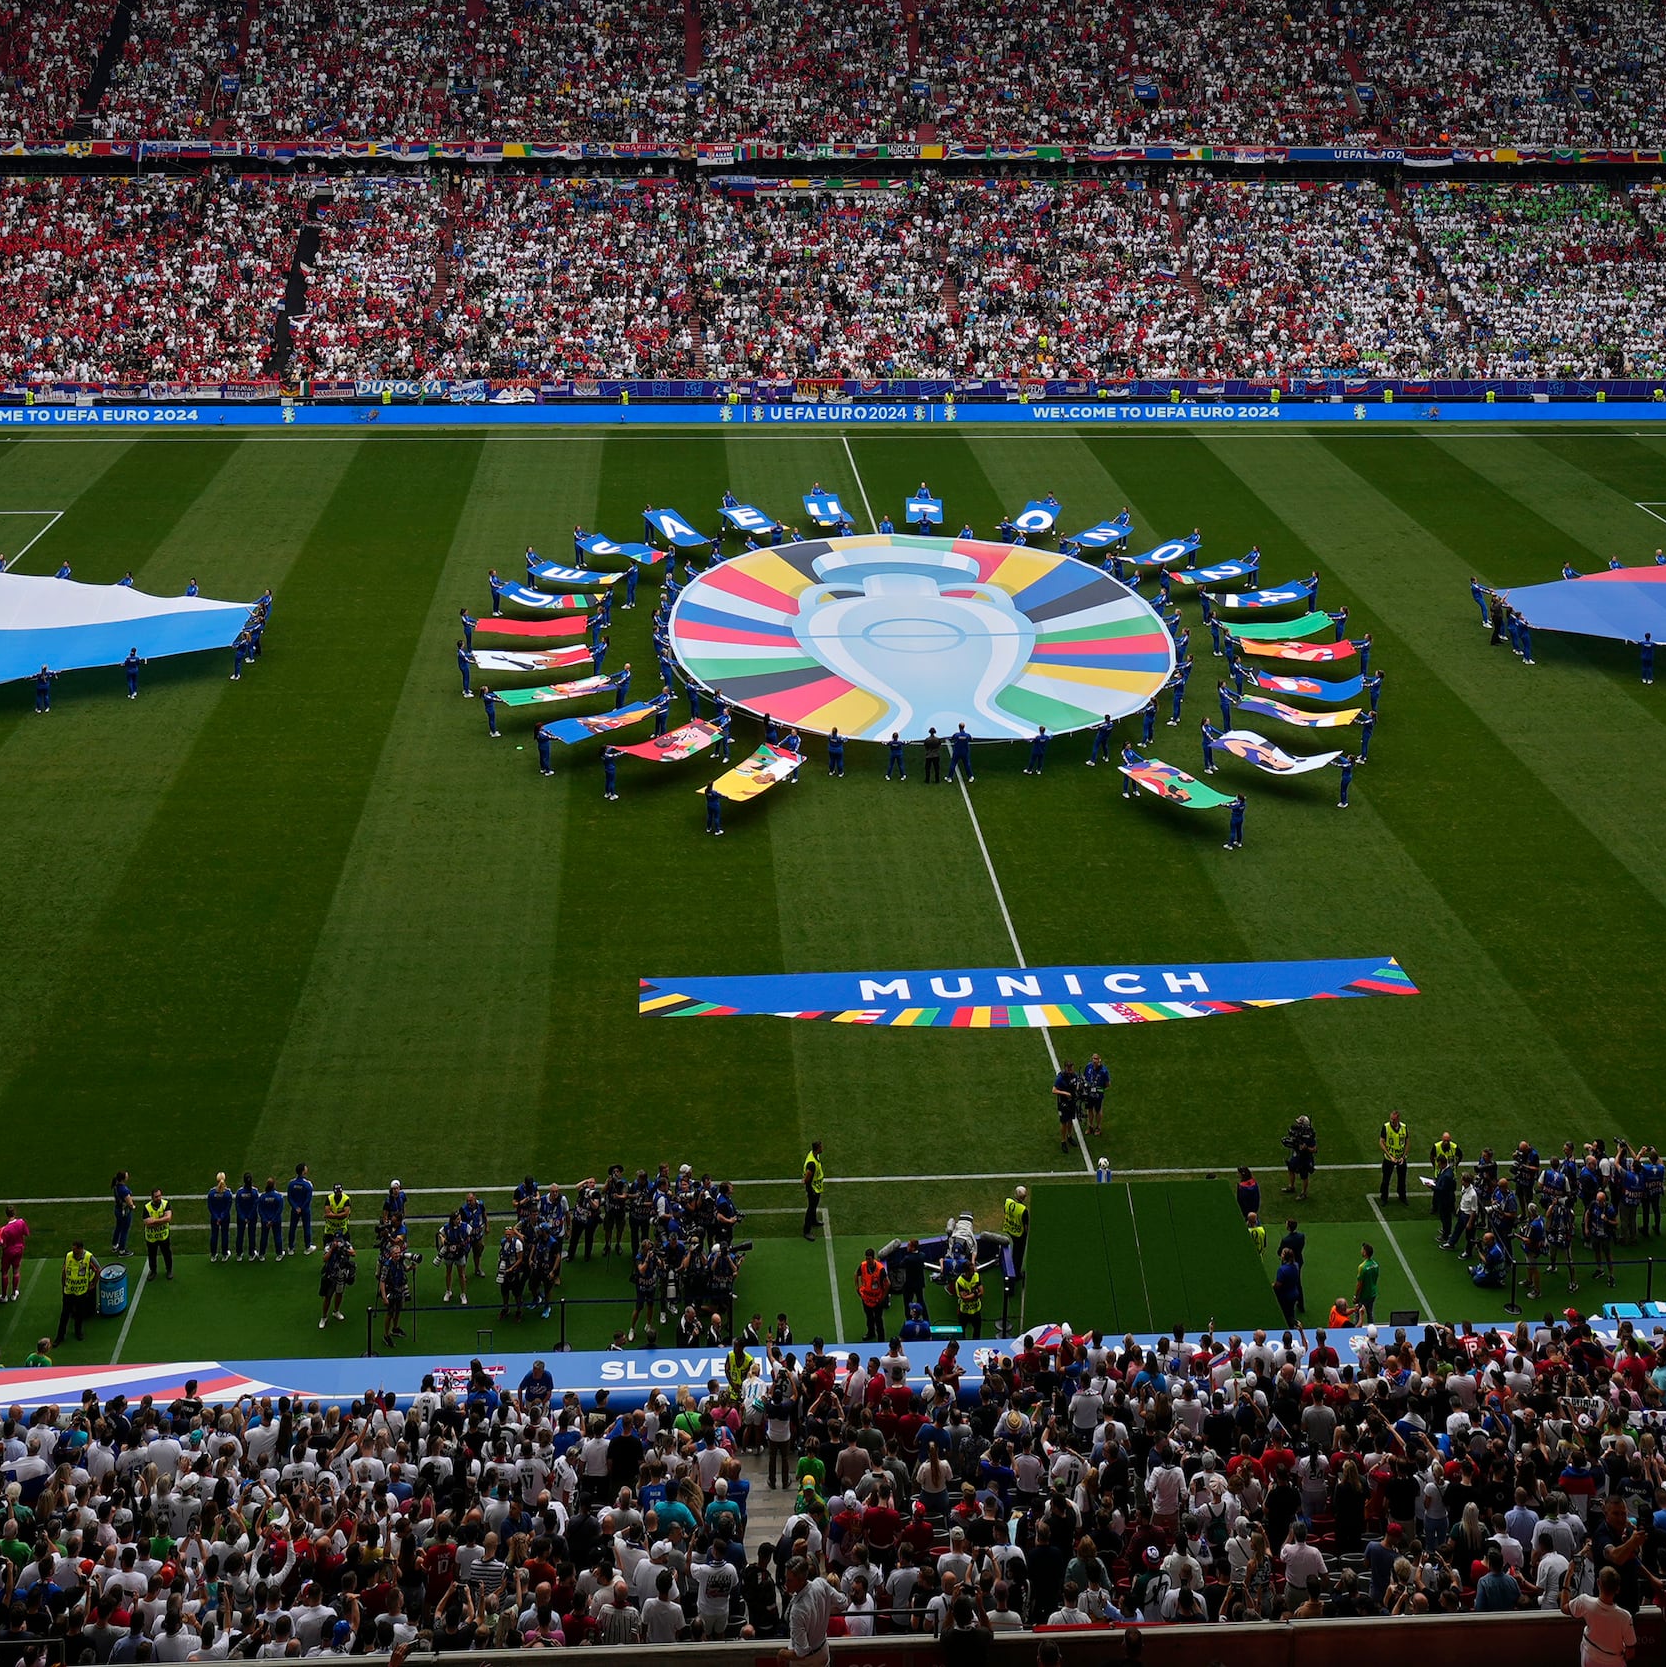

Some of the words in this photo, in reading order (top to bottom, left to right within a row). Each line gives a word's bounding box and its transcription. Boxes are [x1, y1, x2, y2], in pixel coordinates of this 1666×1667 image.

[27, 410, 50, 423] TO
[54, 410, 99, 422] UEFA
[103, 410, 149, 422] EURO
[152, 409, 199, 422] 2024
[1033, 406, 1108, 419] WELCOME
[1111, 406, 1133, 419] TO
[1136, 406, 1179, 418] UEFA
[1182, 406, 1229, 418] EURO
[1232, 406, 1280, 418] 2024
[659, 515, 696, 540] A
[857, 971, 1211, 1001] MUNICH
